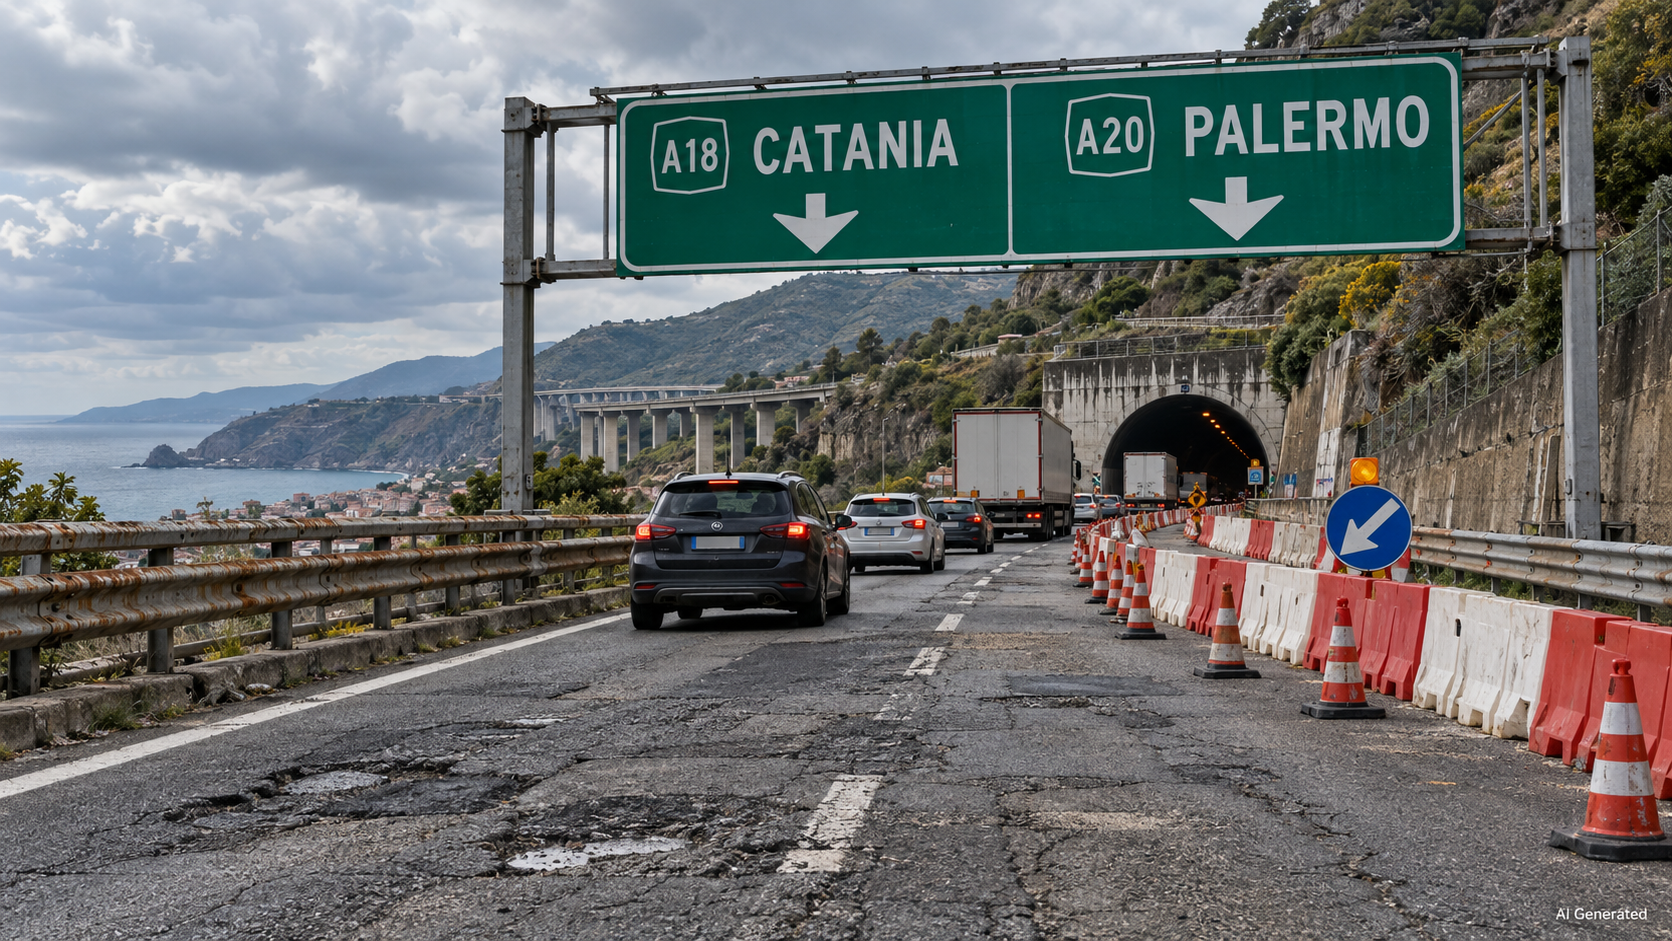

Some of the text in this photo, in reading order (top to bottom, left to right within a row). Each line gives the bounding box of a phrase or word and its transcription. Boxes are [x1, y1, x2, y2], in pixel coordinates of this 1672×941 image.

[661, 118, 959, 175] A18 CATANIA
[1076, 95, 1430, 157] A20 PALERMO
